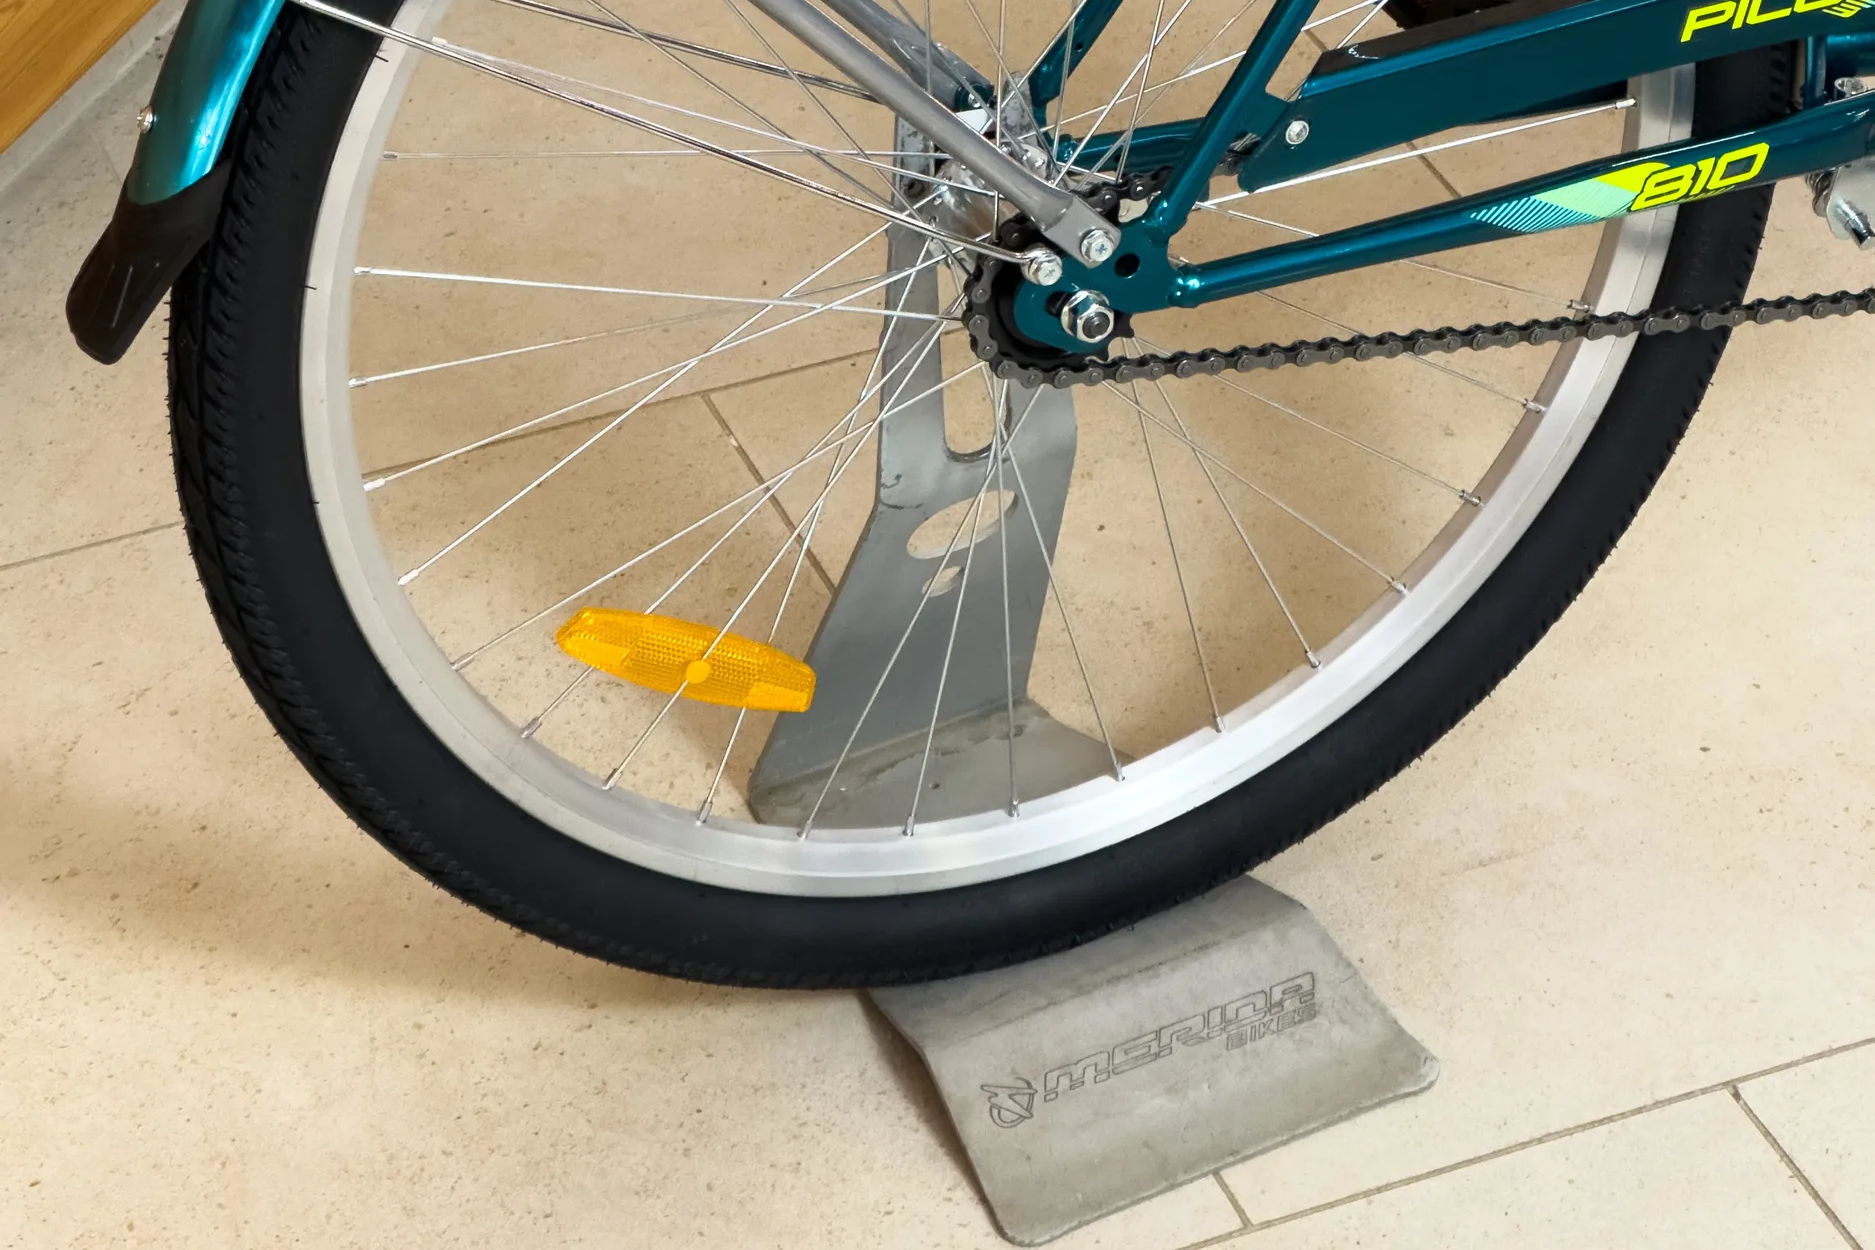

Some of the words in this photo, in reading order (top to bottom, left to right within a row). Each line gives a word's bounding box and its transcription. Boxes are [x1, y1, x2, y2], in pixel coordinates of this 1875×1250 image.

[1630, 142, 1770, 211] 810
[1043, 971, 1316, 1102] MERIDA
[1226, 1001, 1317, 1051] BIKES
